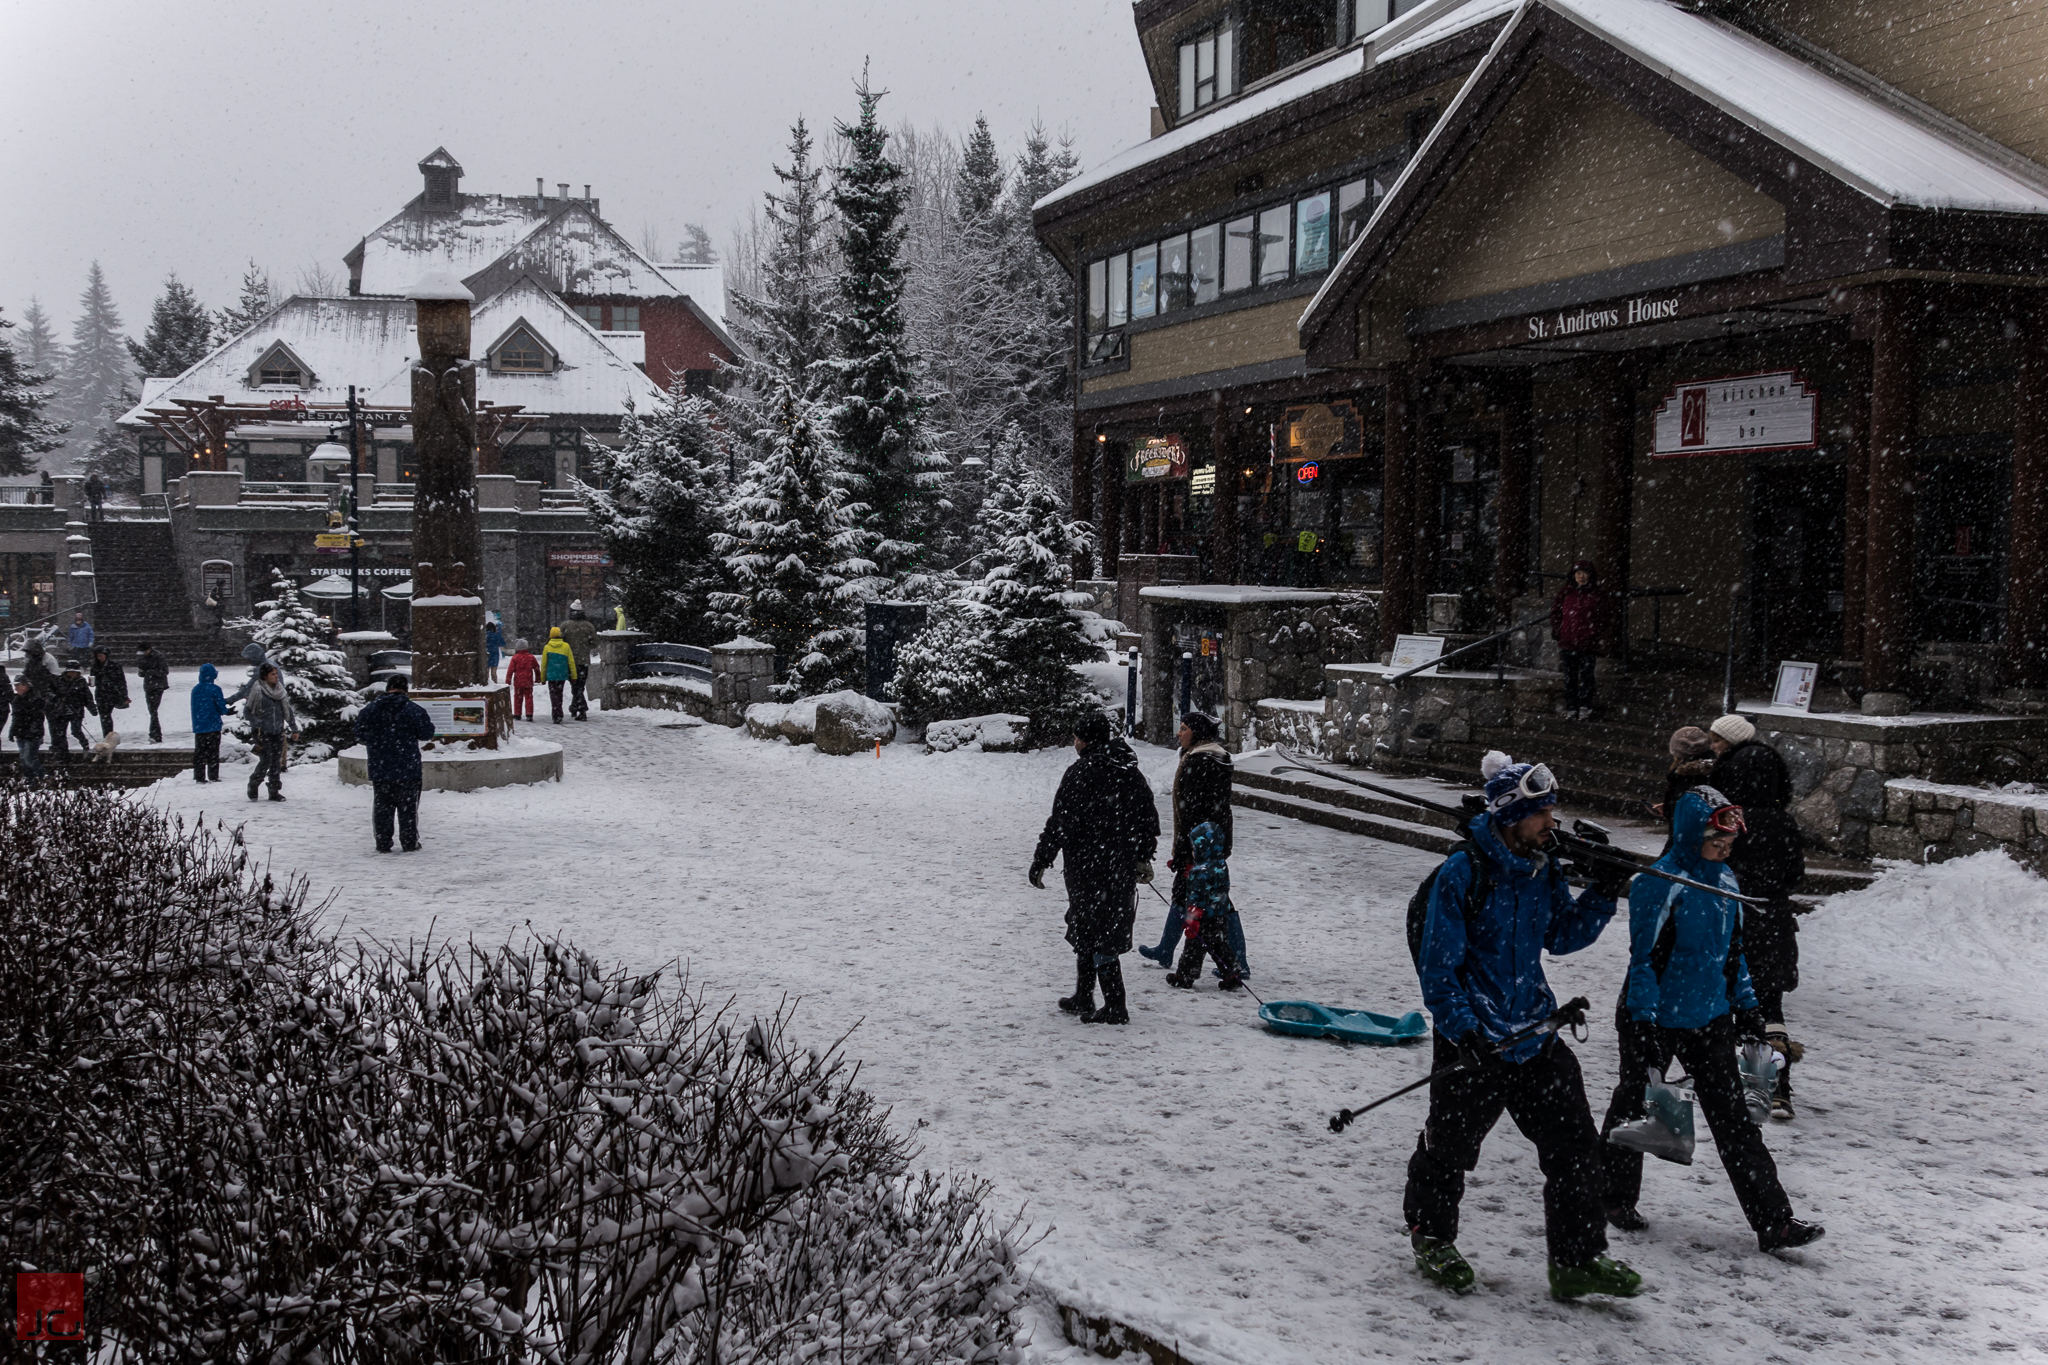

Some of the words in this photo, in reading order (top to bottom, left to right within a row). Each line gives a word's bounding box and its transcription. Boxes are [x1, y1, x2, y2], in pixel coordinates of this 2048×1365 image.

[1528, 316, 1548, 340] St.
[1554, 308, 1619, 335] Andrews
[1627, 297, 1679, 324] House
[1722, 384, 1786, 402] kitchen
[269, 395, 307, 411] earls
[398, 413, 407, 421] &
[1683, 394, 1705, 441] 21
[1739, 425, 1765, 439] bar
[1297, 466, 1318, 480] OPEN
[310, 568, 371, 576] STARBUKS
[373, 568, 412, 576] COFFEE
